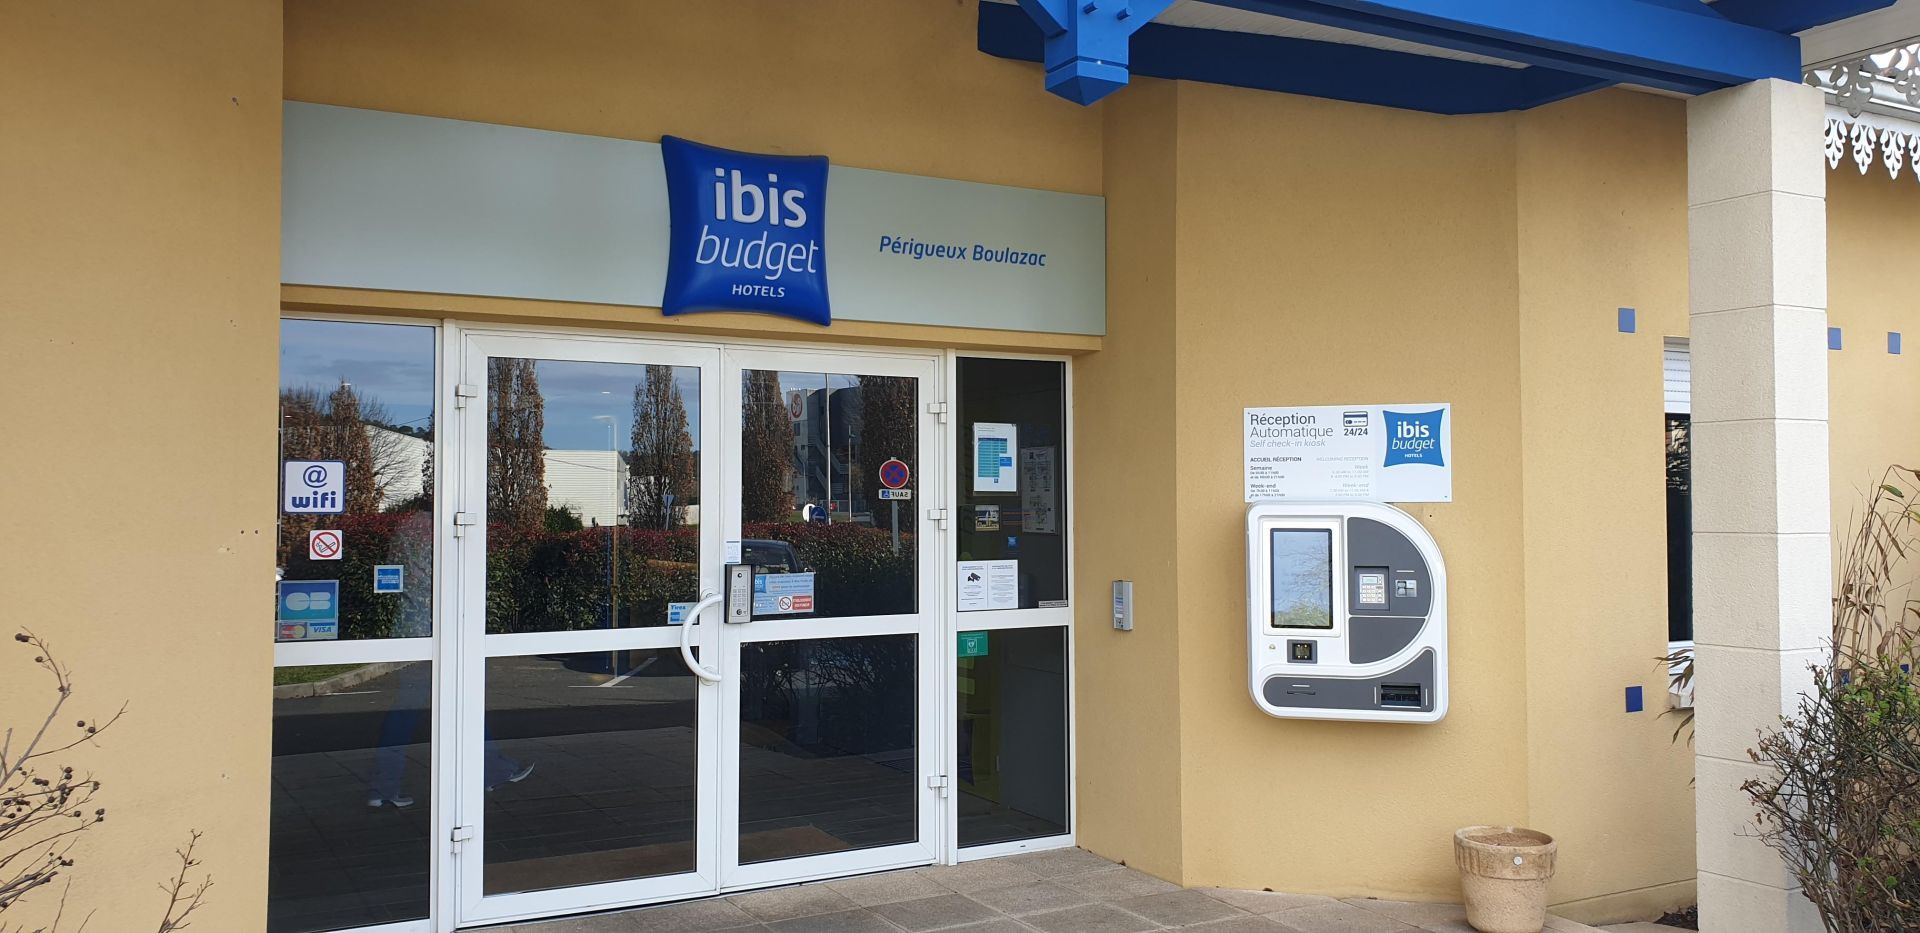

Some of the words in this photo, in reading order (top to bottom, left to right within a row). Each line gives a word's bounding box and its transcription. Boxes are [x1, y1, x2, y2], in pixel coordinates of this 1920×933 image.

[715, 167, 807, 228] ibis
[695, 224, 819, 281] budget
[879, 235, 967, 260] Périgueux
[972, 244, 1047, 267] Boulazac
[732, 284, 786, 298] HOTELS
[1250, 412, 1316, 427] Réception
[1250, 425, 1334, 439] Automatique
[1343, 428, 1369, 436] 24/24
[1397, 421, 1430, 438] ibis
[1250, 440, 1266, 448] Self
[1304, 439, 1326, 447] kiosk
[1391, 437, 1436, 452] budget
[291, 490, 337, 508] wifi
